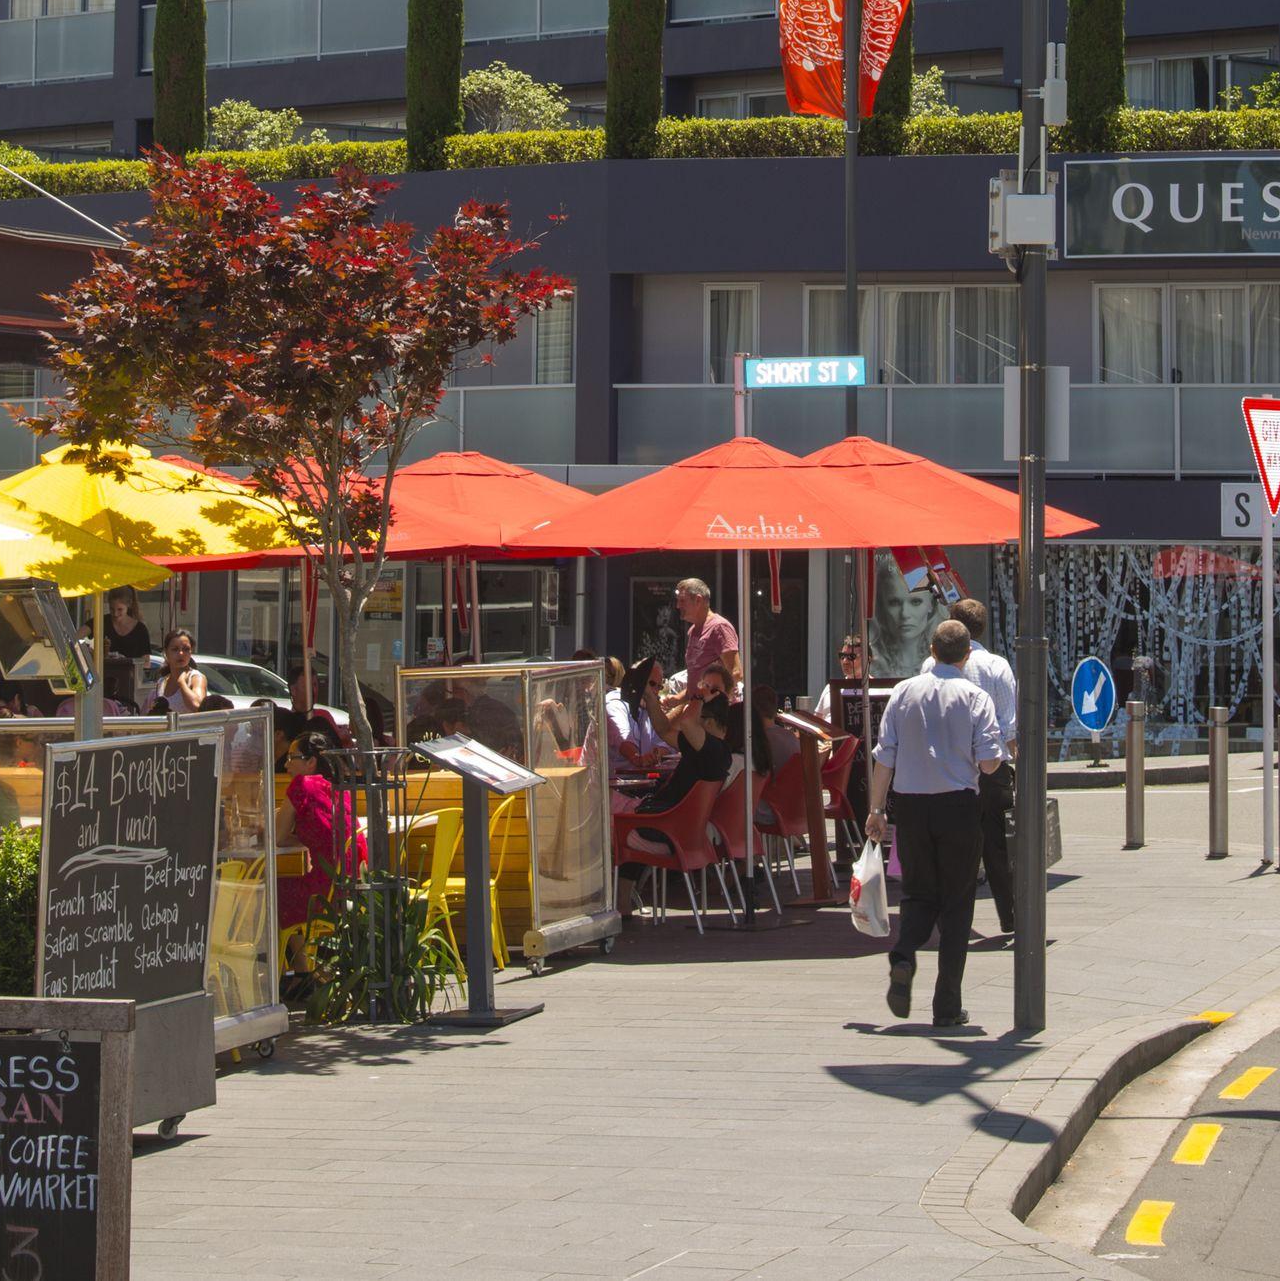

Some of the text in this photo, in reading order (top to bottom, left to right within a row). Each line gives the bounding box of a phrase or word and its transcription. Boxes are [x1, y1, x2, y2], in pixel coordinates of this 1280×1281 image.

[756, 362, 840, 384] SHORT ST
[706, 514, 820, 536] Archie's
[55, 742, 198, 817] $14 Breakfast
[77, 811, 100, 849] and
[144, 852, 207, 897] Beef burger
[48, 881, 85, 925] French
[45, 926, 79, 960] Safran
[72, 947, 119, 995] benedict
[9, 1135, 89, 1170] COFFEE
